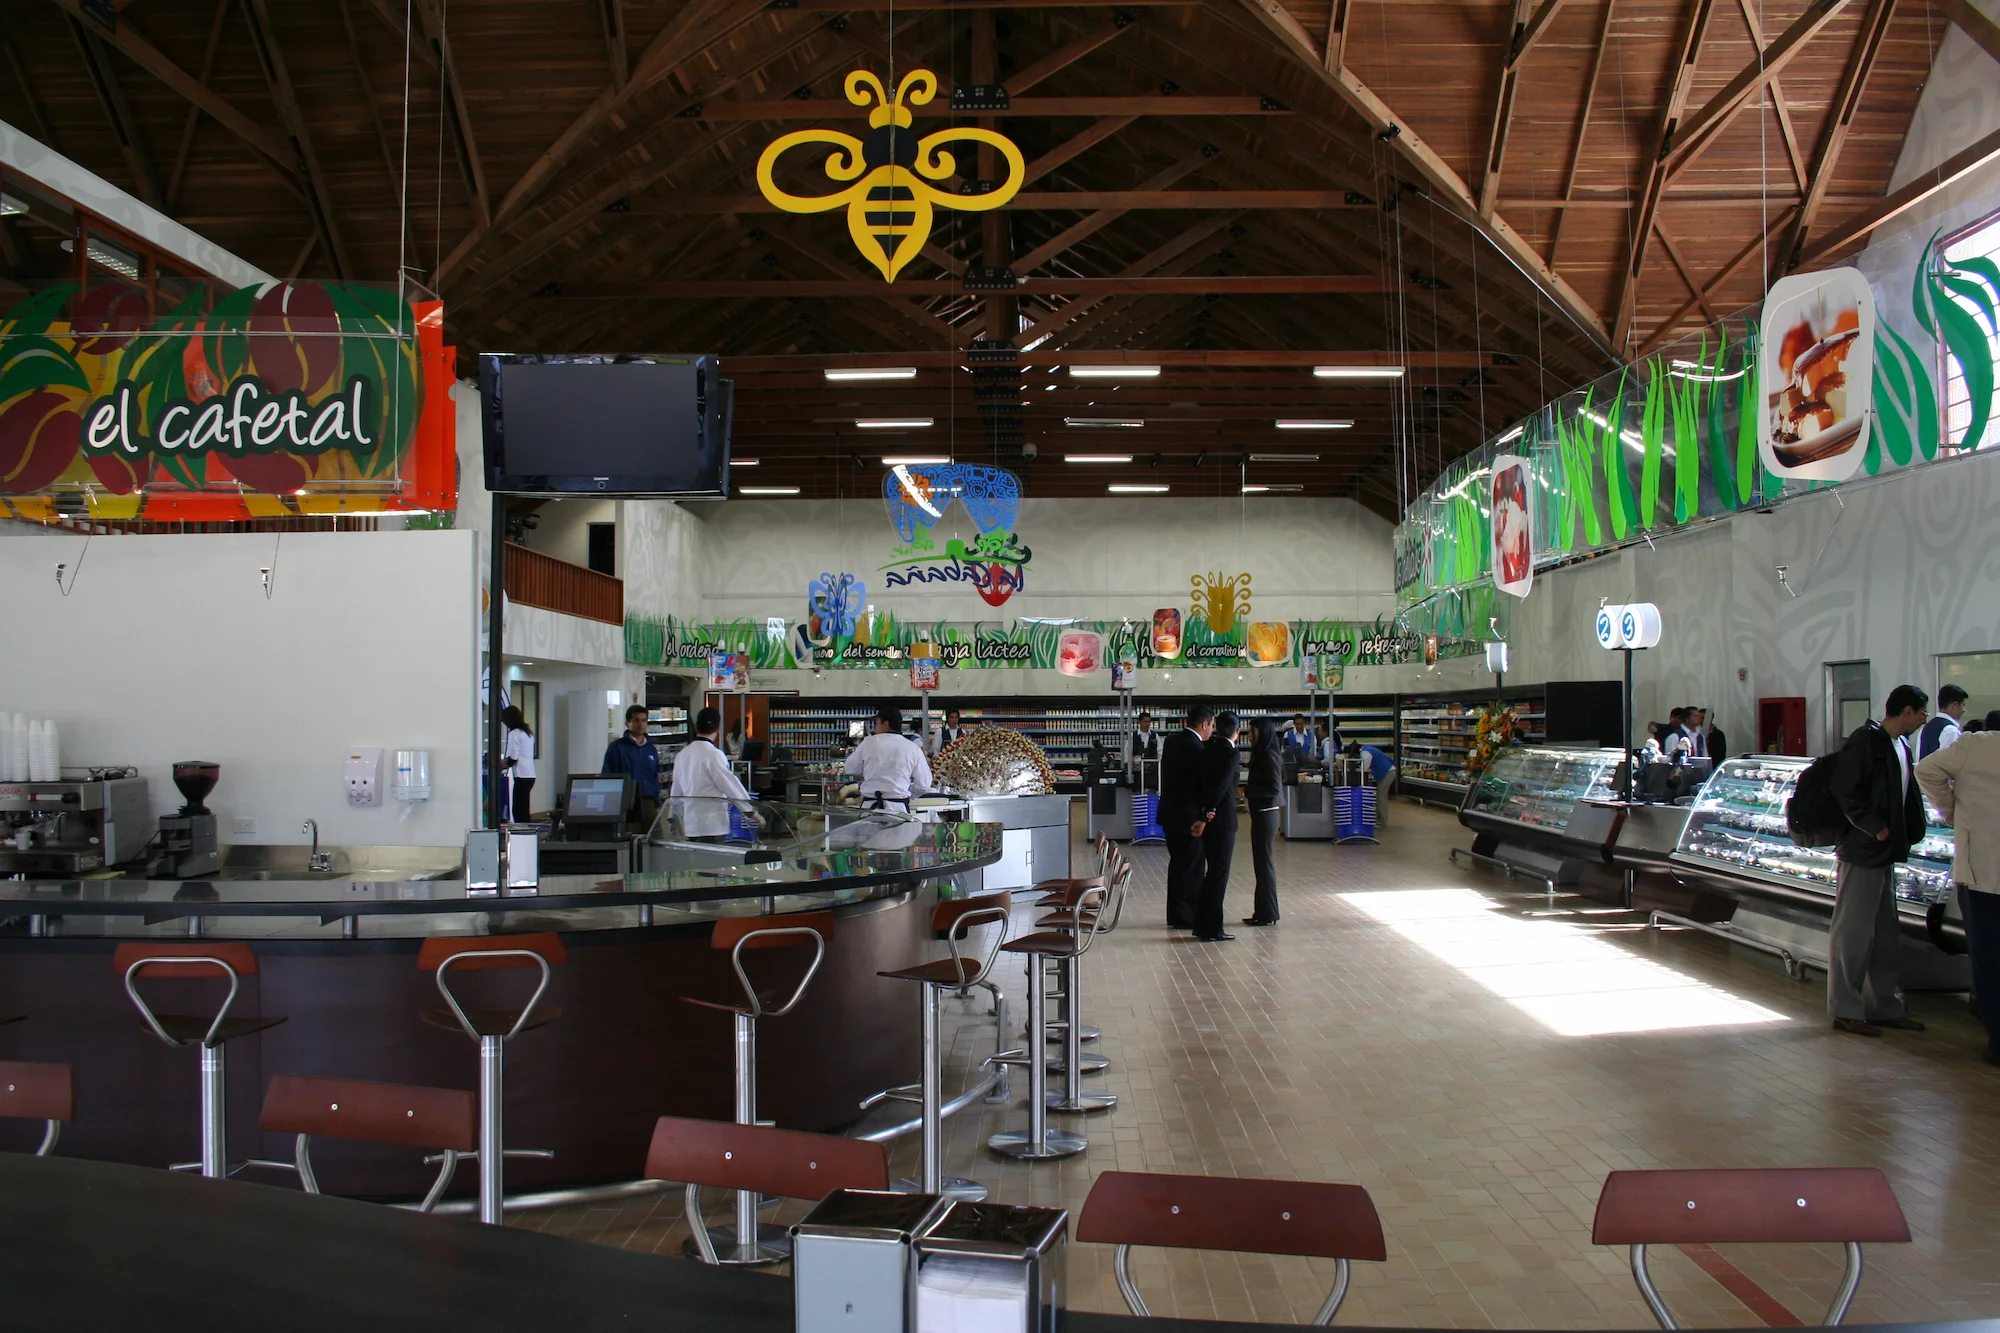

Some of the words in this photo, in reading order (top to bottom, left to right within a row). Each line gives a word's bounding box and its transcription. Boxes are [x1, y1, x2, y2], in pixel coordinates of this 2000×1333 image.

[88, 388, 139, 453] el
[159, 381, 372, 449] cafetal
[1599, 616, 1609, 640] 2
[1624, 614, 1634, 640] 3
[667, 637, 677, 658] el
[843, 644, 863, 658] del
[1186, 644, 1197, 657] el
